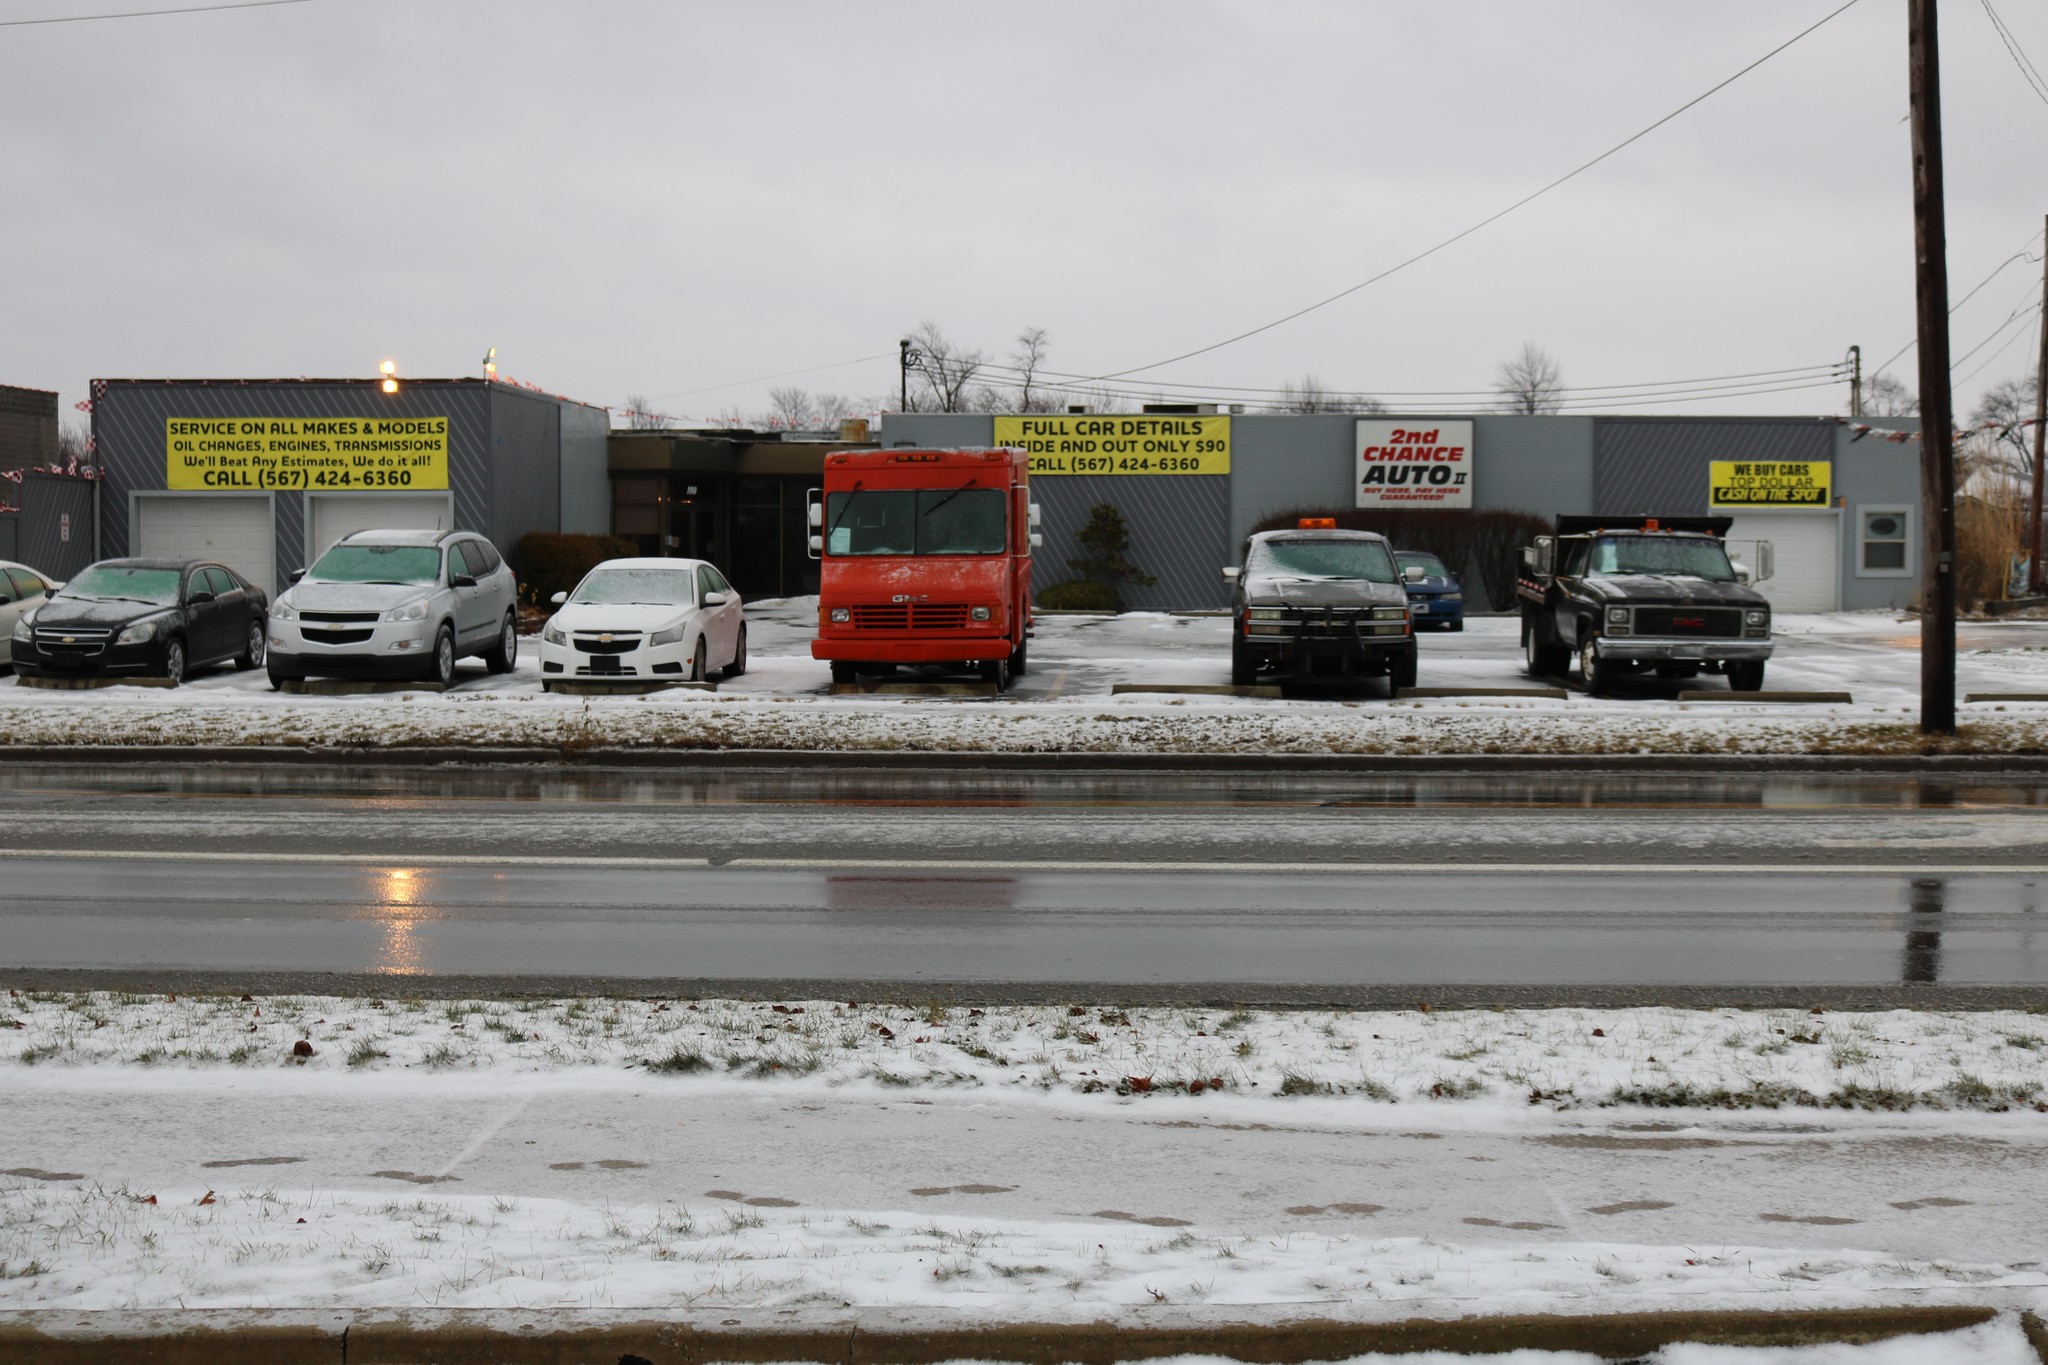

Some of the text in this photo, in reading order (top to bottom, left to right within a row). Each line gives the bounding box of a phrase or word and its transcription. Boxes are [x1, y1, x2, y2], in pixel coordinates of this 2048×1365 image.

[170, 422, 445, 435] SERVICE ON ALL MAKES & MODELS
[1022, 421, 1203, 435] FULL CAR DETAILS
[1389, 429, 1439, 444] 2nd
[174, 440, 442, 453] OIL CHANGES, ENGINES, TRANSMISSIONS
[1060, 440, 1097, 453] AND
[1102, 440, 1138, 453] OUT
[1143, 440, 1190, 453] ONLY
[1195, 440, 1226, 454] $90
[1363, 447, 1465, 462] CHANCE
[184, 455, 431, 469] We'll Beat Any Estimates, We do it all!
[1028, 457, 1199, 473] CALL (567) 424-6360
[1361, 465, 1452, 485] AUTO
[1734, 464, 1809, 476] WE BUY CARS
[203, 469, 411, 488] CALL (567) 424-6360
[1728, 477, 1814, 488] TOP DOLLAR
[1718, 488, 1748, 501] CASH
[1749, 488, 1768, 501] ON
[1791, 488, 1821, 501] SPOT
